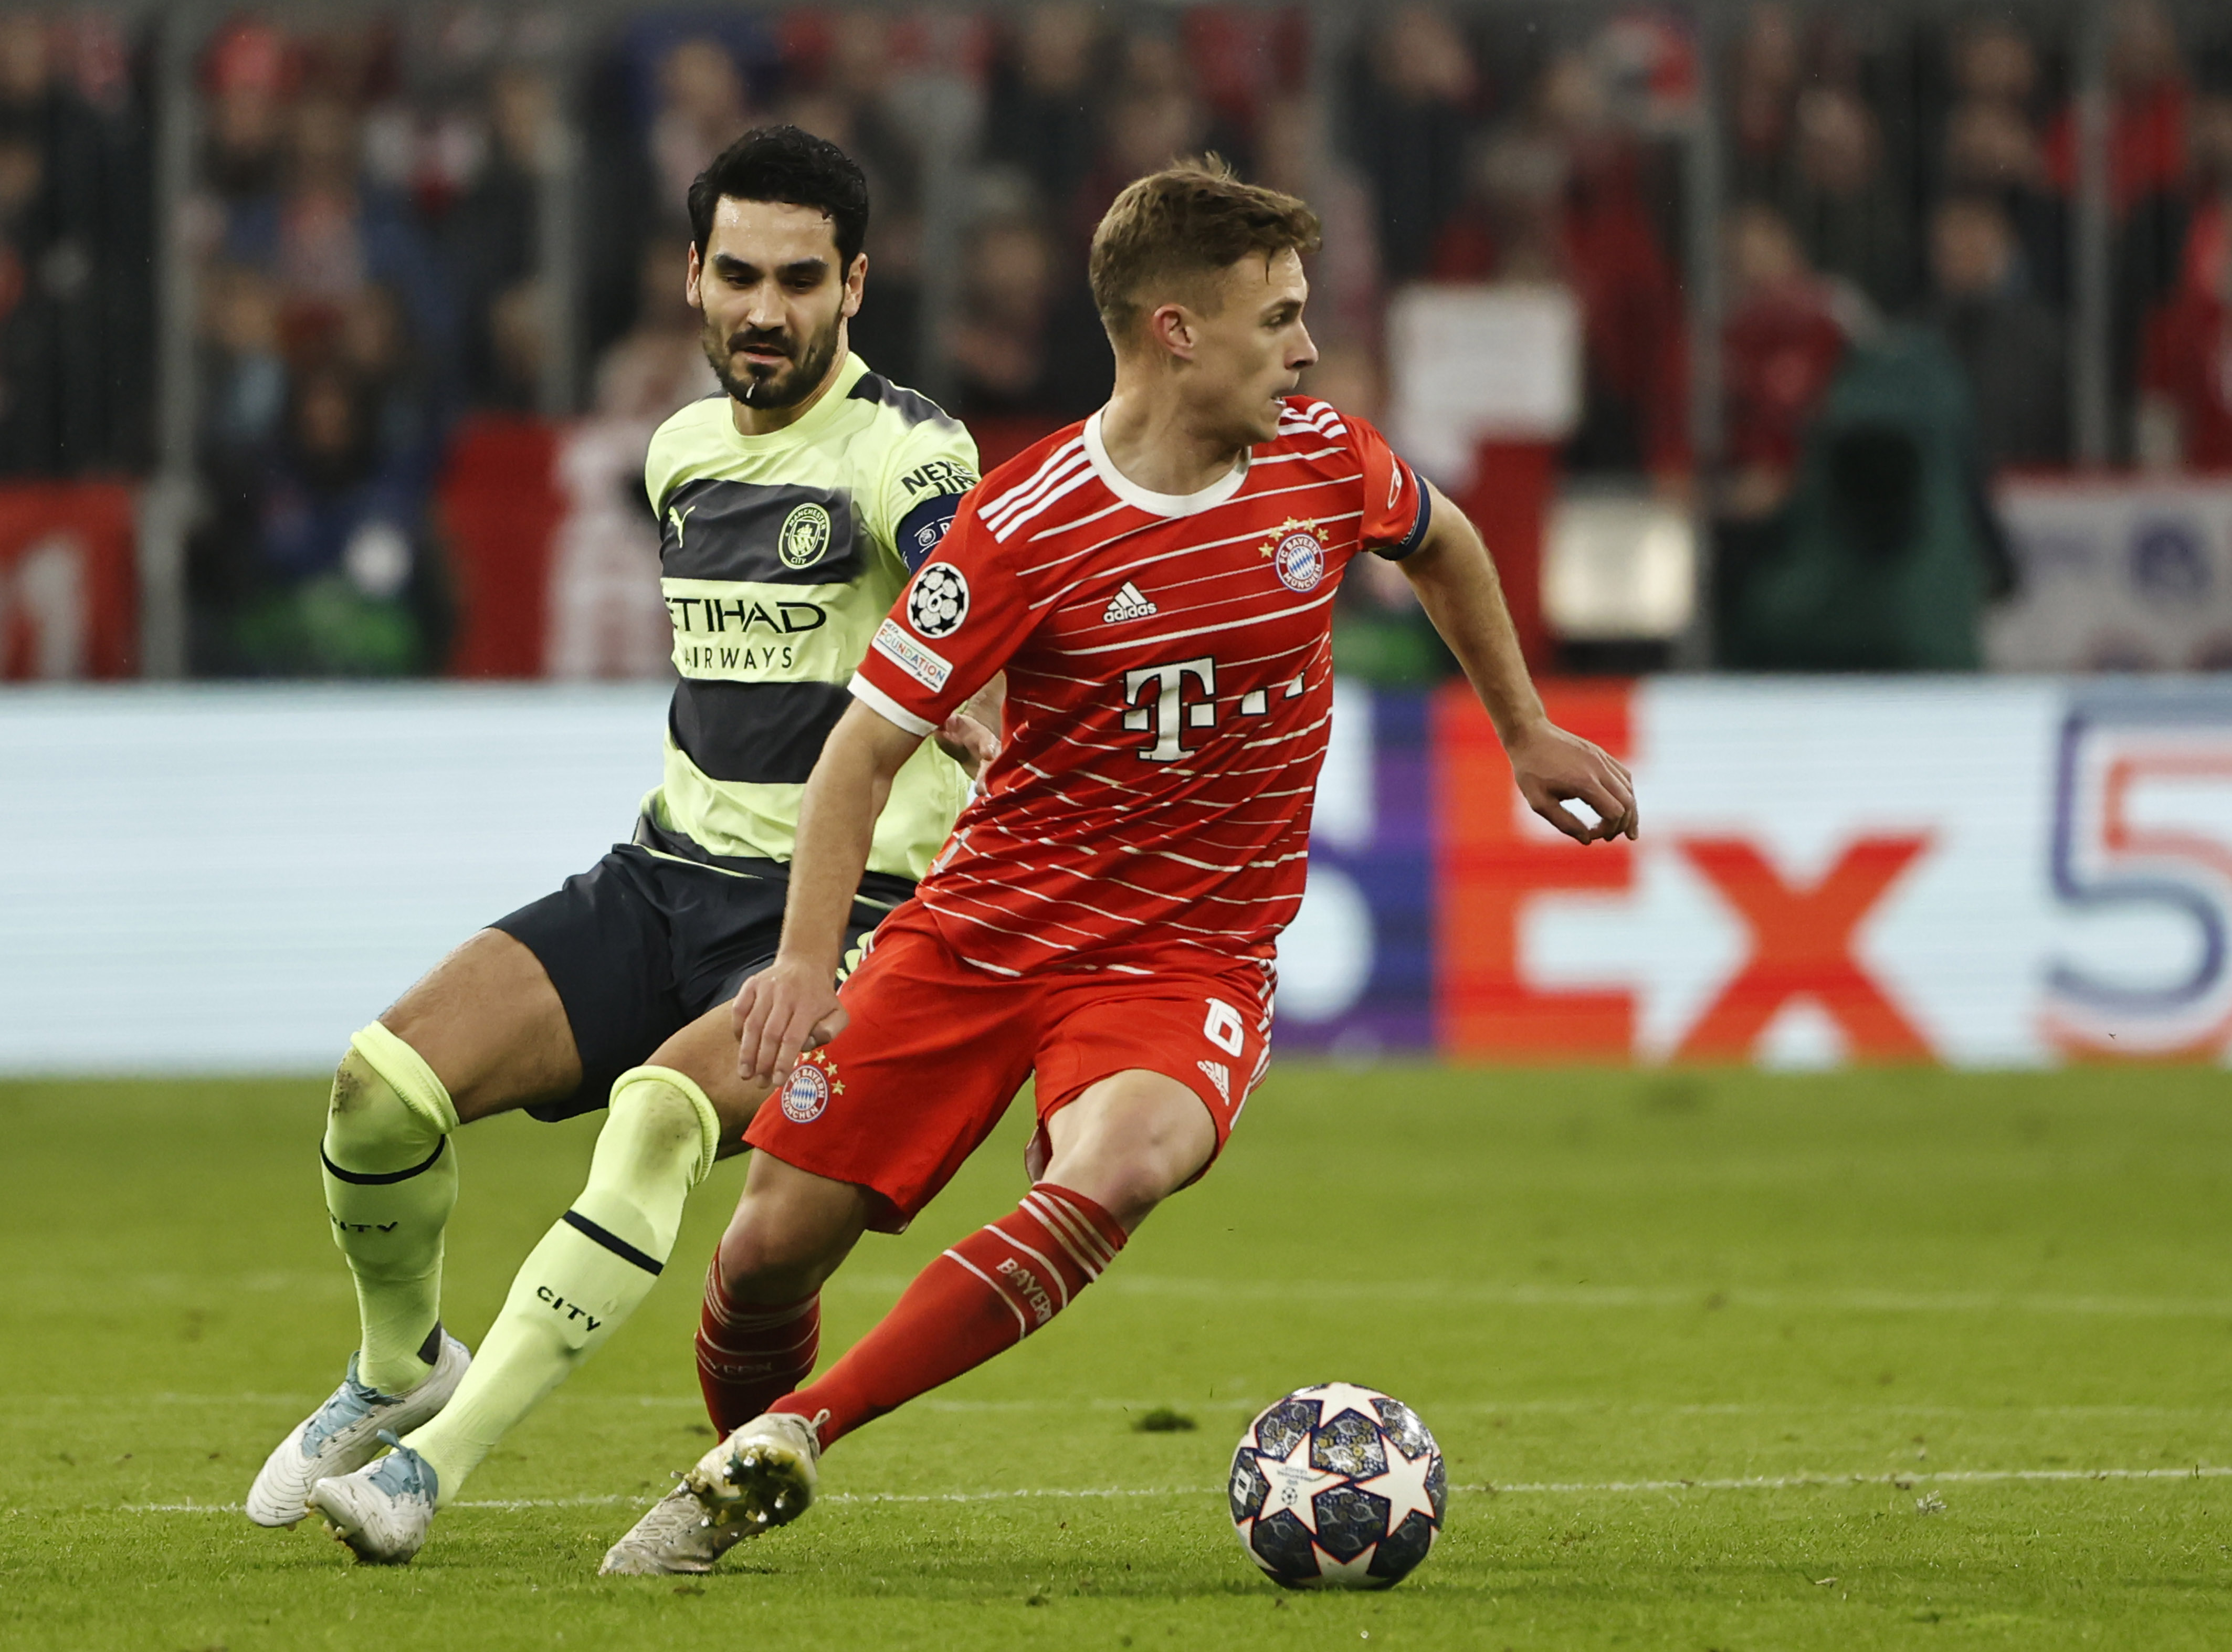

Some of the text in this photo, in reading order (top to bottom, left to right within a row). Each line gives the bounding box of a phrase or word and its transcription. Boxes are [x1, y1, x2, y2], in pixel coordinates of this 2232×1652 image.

[789, 509, 827, 530] MANCHESTER
[1279, 538, 1319, 564] FC BAYERN
[1103, 603, 1157, 623] adidas
[878, 628, 945, 681] FOUNDATION
[1205, 997, 1245, 1057] 6
[802, 1068, 825, 1098] BAYERN
[537, 1286, 601, 1332] CITY
